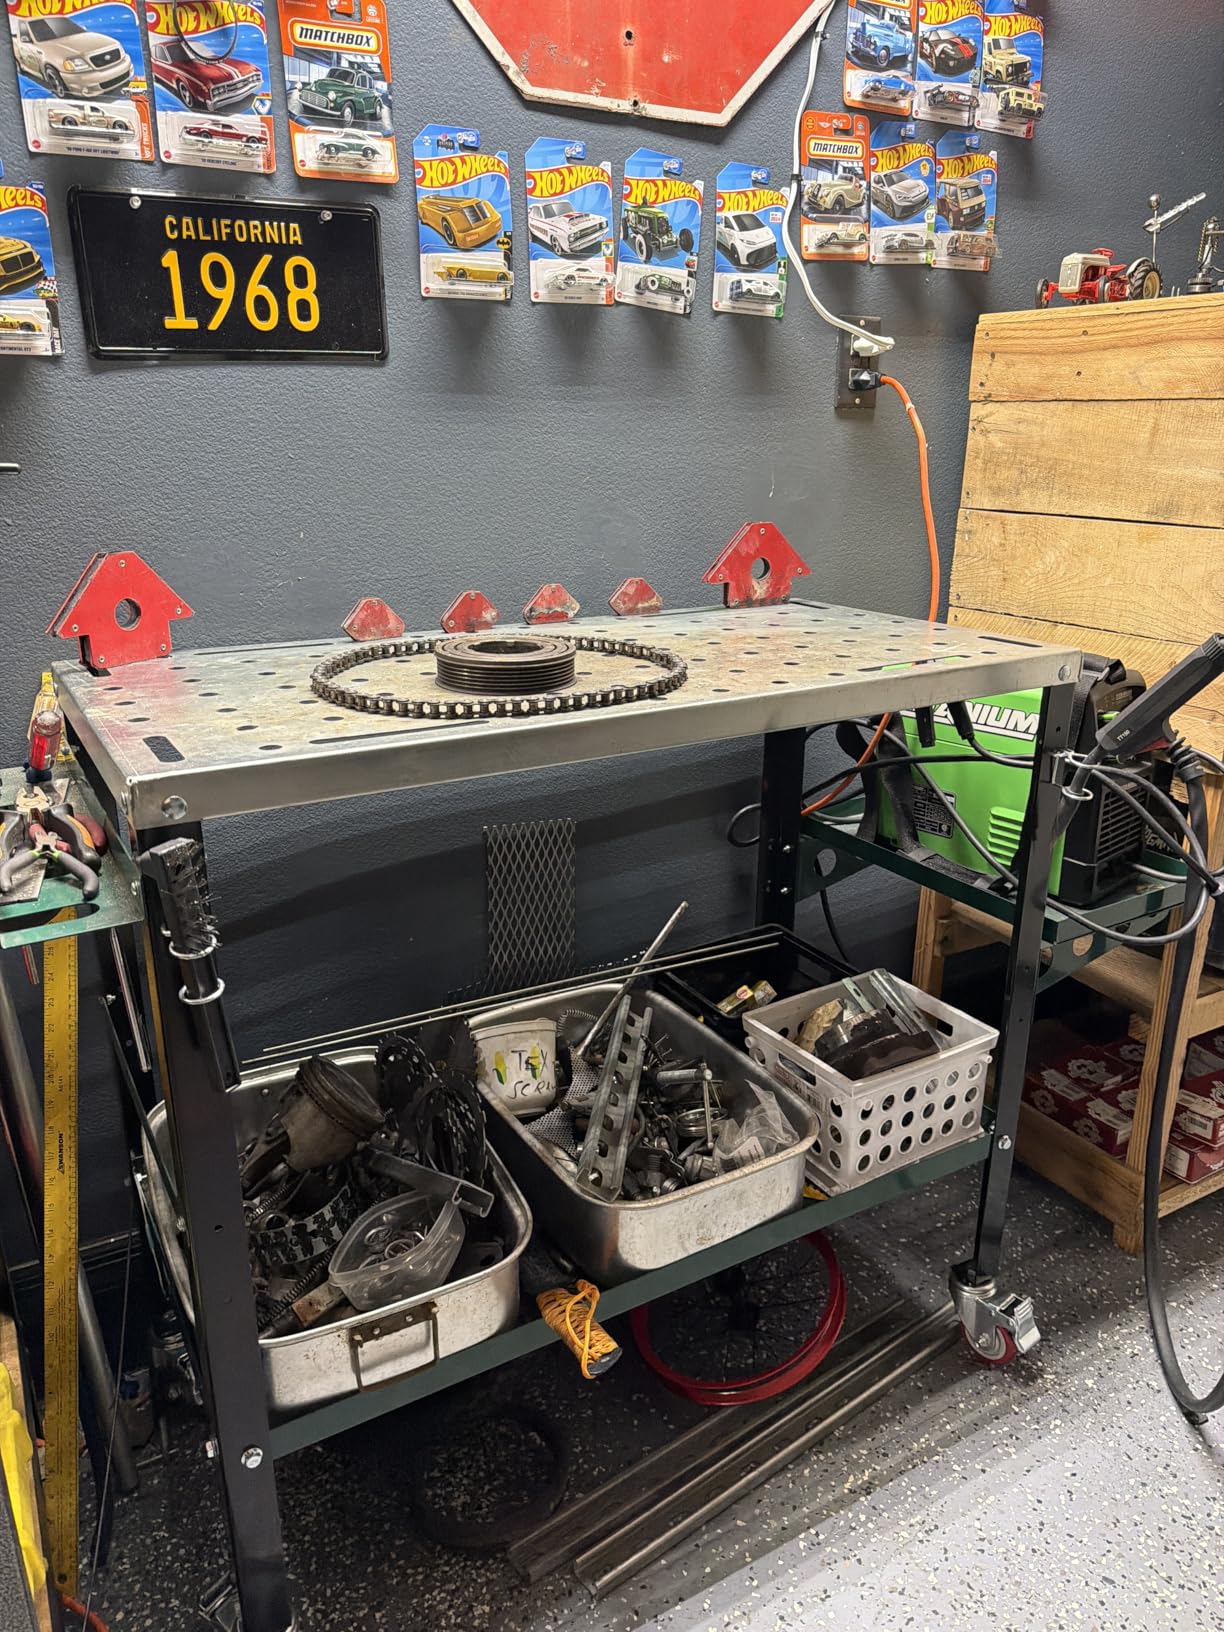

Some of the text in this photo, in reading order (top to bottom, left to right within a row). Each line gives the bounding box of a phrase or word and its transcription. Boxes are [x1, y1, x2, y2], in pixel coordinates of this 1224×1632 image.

[154, 3, 198, 35] HOT
[923, 0, 982, 25] HOT WHEELS
[989, 15, 1044, 37] HOT WHEELS
[298, 25, 373, 47] MATCHBOX
[812, 141, 860, 155] MATCHBOX
[876, 143, 934, 173] HOT WHEELS
[419, 155, 506, 188] HOT WHEELS
[942, 153, 996, 180] HOT WHEELS
[532, 166, 608, 198] HOT WHEELS
[629, 179, 700, 205] HOT WHEELS
[0, 186, 43, 208] EELS
[724, 189, 787, 213] HOT WHEELS
[164, 214, 303, 246] CALIFORNIA
[160, 248, 320, 332] 1968
[511, 1049, 548, 1077] TEX
